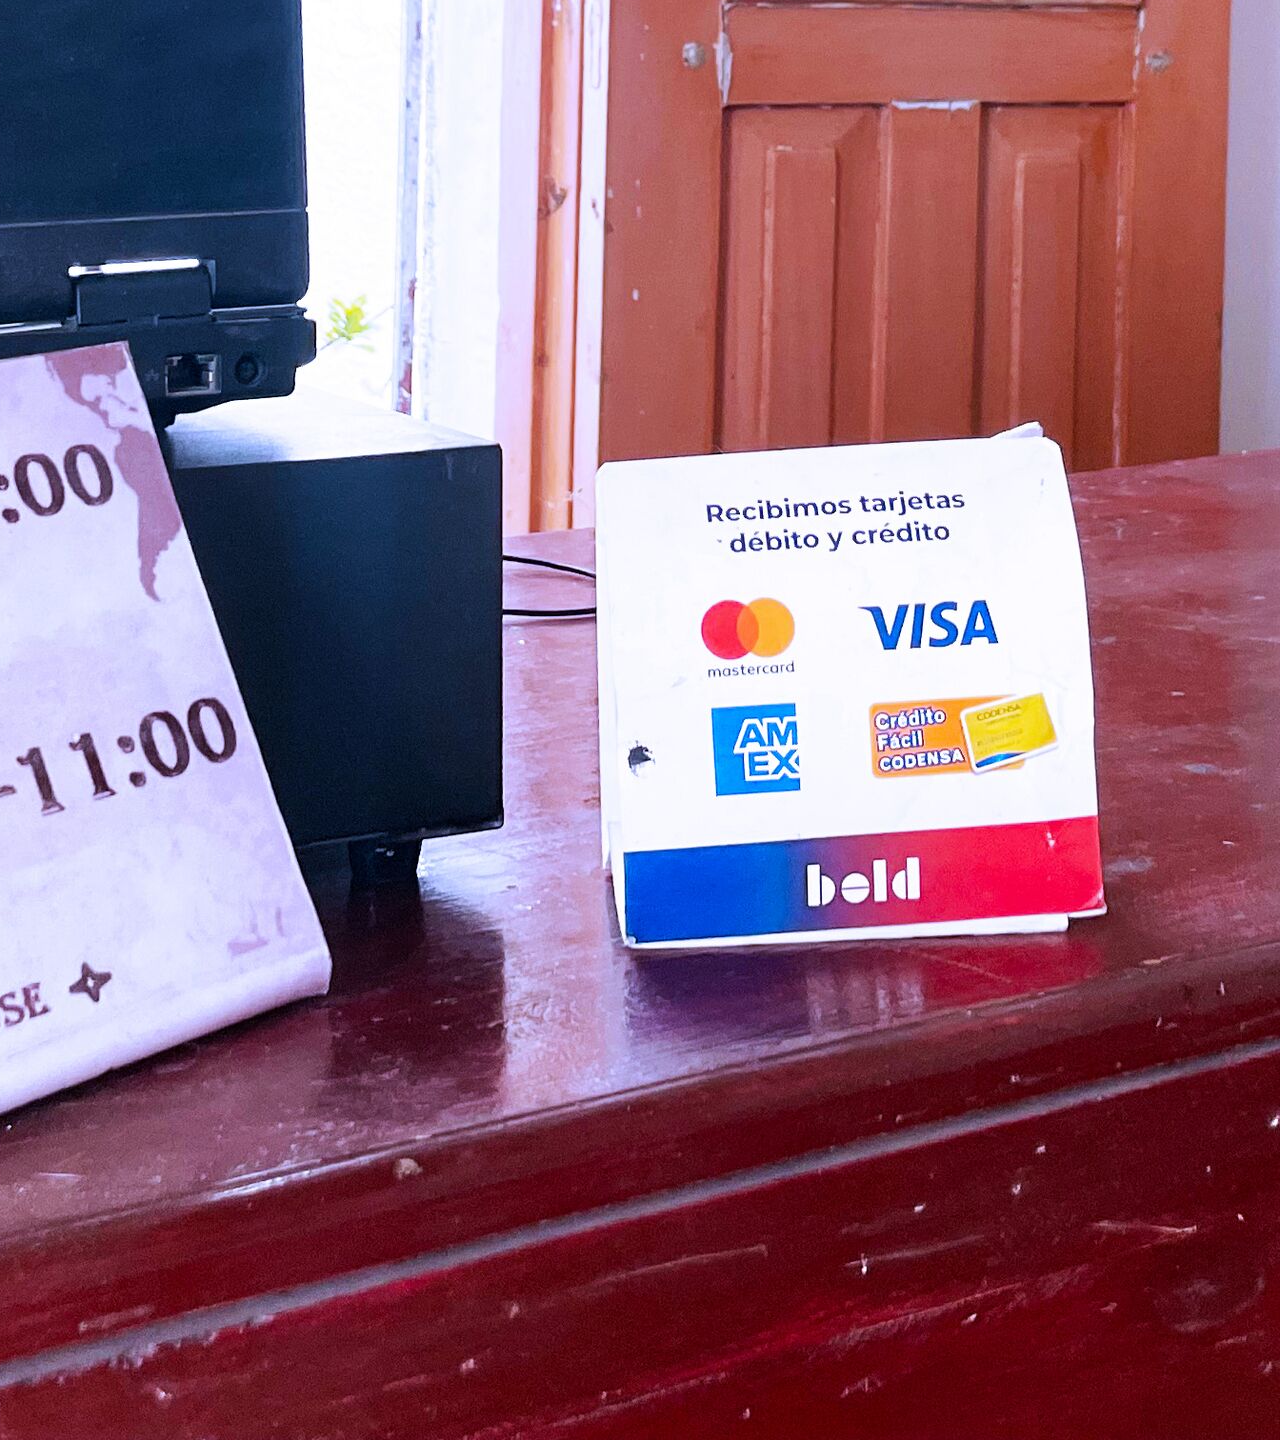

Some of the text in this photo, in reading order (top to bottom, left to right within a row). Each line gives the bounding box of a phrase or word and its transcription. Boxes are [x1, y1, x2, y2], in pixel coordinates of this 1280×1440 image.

[705, 489, 966, 524] Recibimos tarjetas
[729, 522, 951, 554] débito y crédito
[857, 599, 999, 651] VISA
[707, 660, 796, 679] mastercard
[874, 706, 947, 731] Crédito
[736, 718, 798, 751] AM
[876, 729, 925, 752] Fácil
[747, 748, 800, 779] EX
[878, 747, 965, 772] CODENSA
[806, 856, 921, 908] bold
